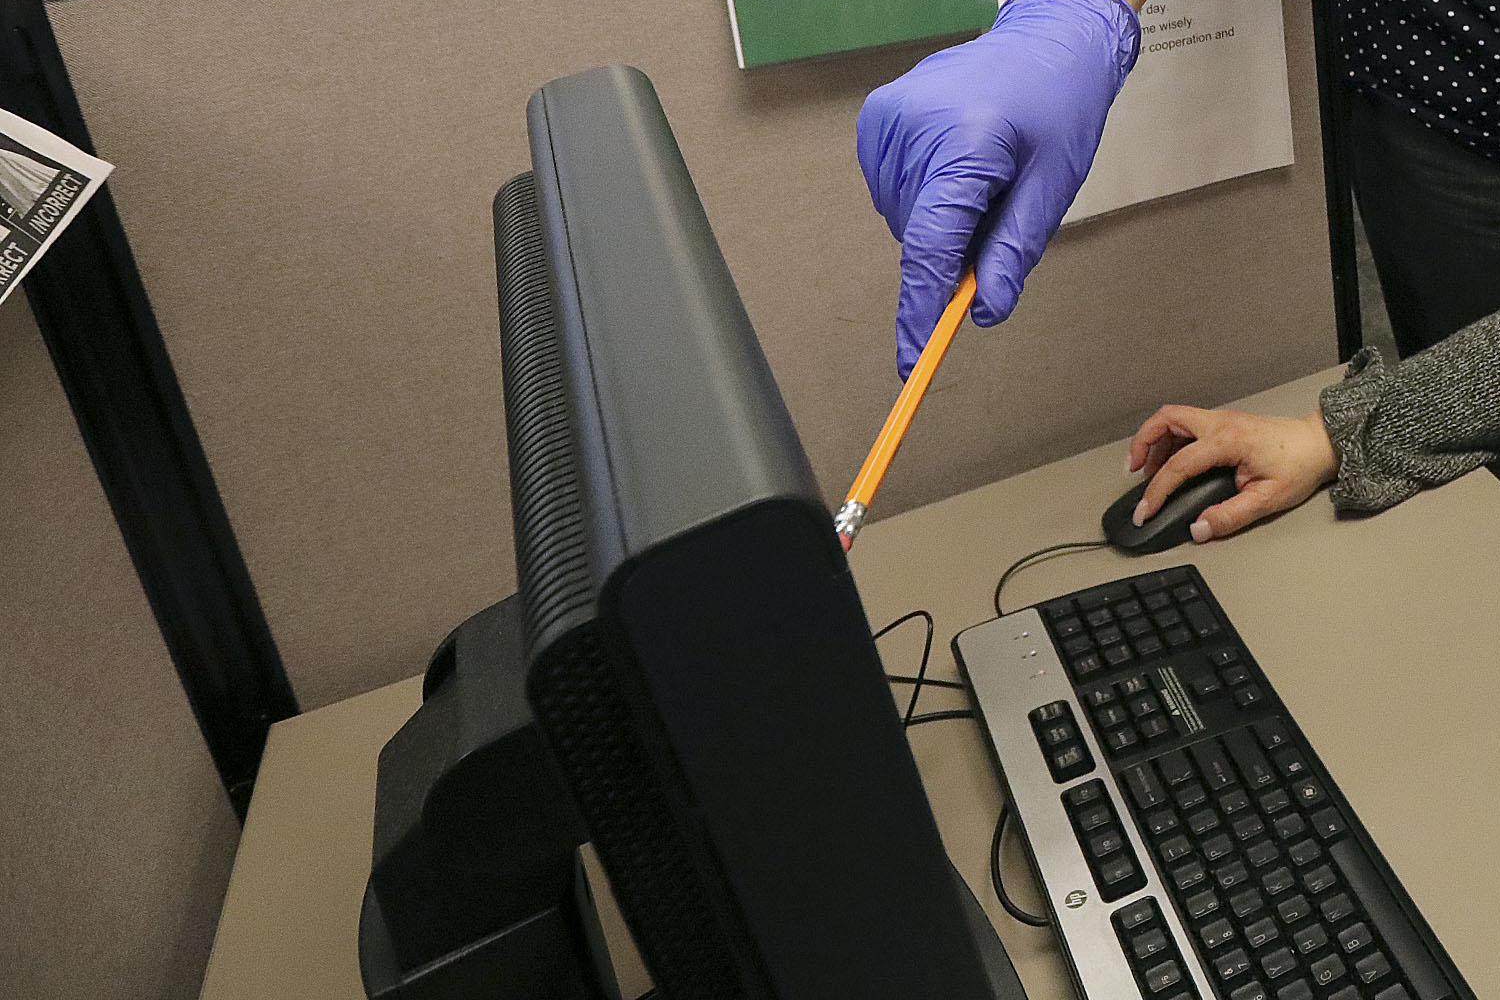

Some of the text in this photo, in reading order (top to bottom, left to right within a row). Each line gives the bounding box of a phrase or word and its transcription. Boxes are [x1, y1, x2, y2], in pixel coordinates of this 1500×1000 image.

[1149, 32, 1212, 52] cooperation
[1215, 26, 1235, 40] and
[28, 173, 84, 235] INCORRECT
[1065, 889, 1088, 909] hp
